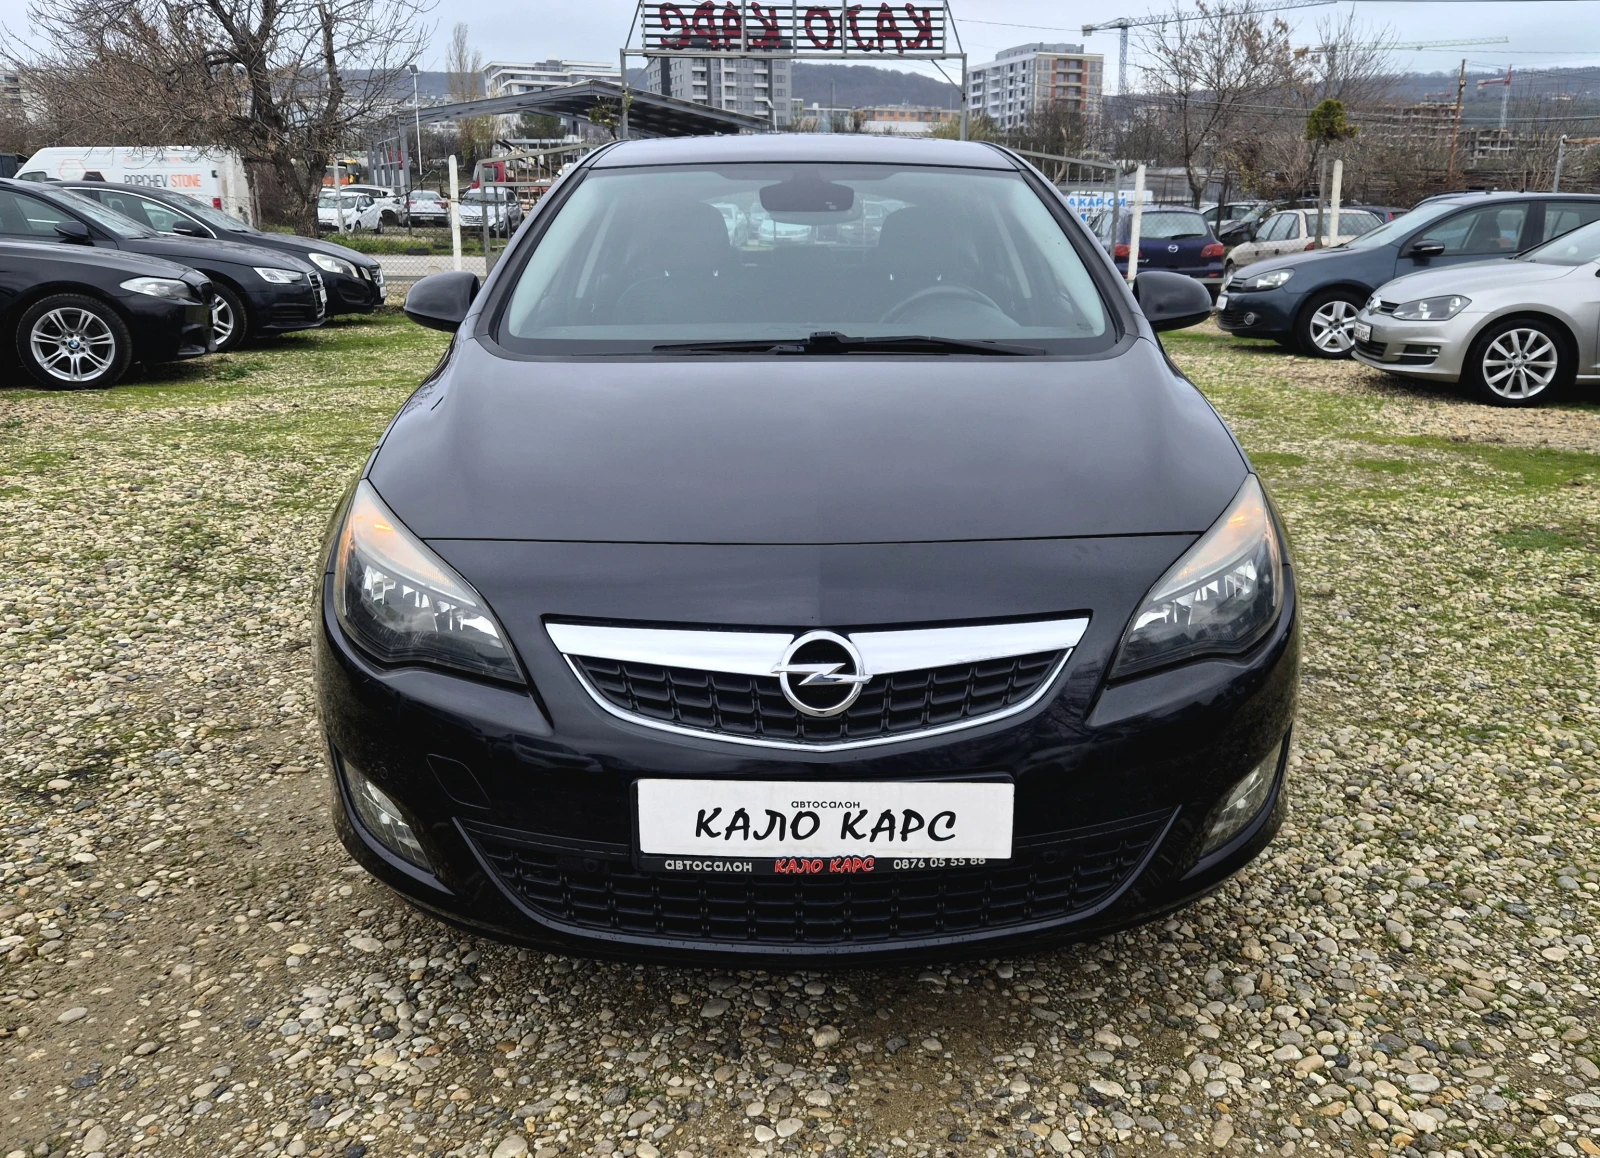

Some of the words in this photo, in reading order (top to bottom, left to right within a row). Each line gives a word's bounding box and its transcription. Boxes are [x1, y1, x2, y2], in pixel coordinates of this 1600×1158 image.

[123, 174, 168, 187] POPCHEV
[170, 174, 202, 188] STONE
[791, 800, 860, 809] автосалон
[695, 807, 821, 841] КАЛО
[840, 809, 957, 842] КАРС
[664, 859, 752, 872] автосалон
[774, 858, 824, 875] КАЛО
[829, 857, 875, 874] КАРС
[893, 858, 926, 870] 0876
[929, 858, 946, 868] 05
[949, 858, 966, 866] 55
